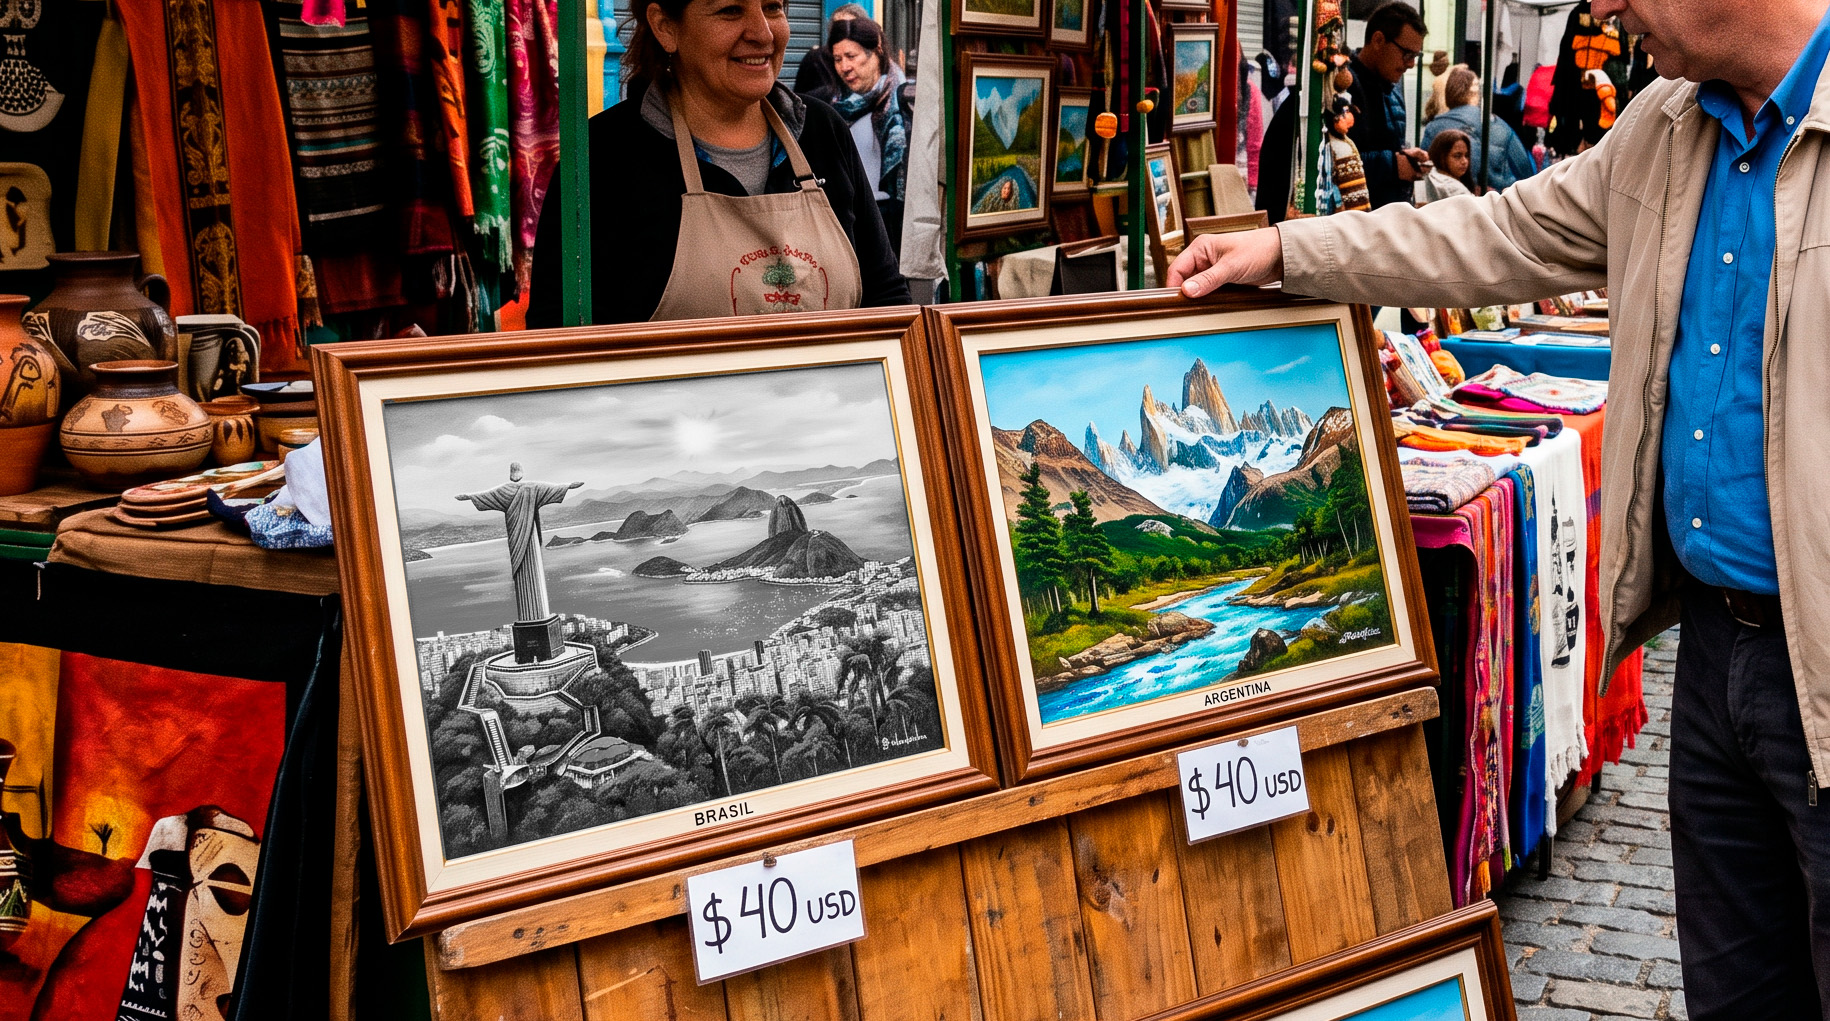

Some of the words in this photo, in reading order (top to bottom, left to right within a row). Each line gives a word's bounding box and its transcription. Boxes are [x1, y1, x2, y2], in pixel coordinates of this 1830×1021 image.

[1204, 680, 1272, 707] ARGENTINA
[1264, 769, 1302, 798] USD
[694, 801, 754, 826] BRASIL
[806, 889, 856, 924] USD
